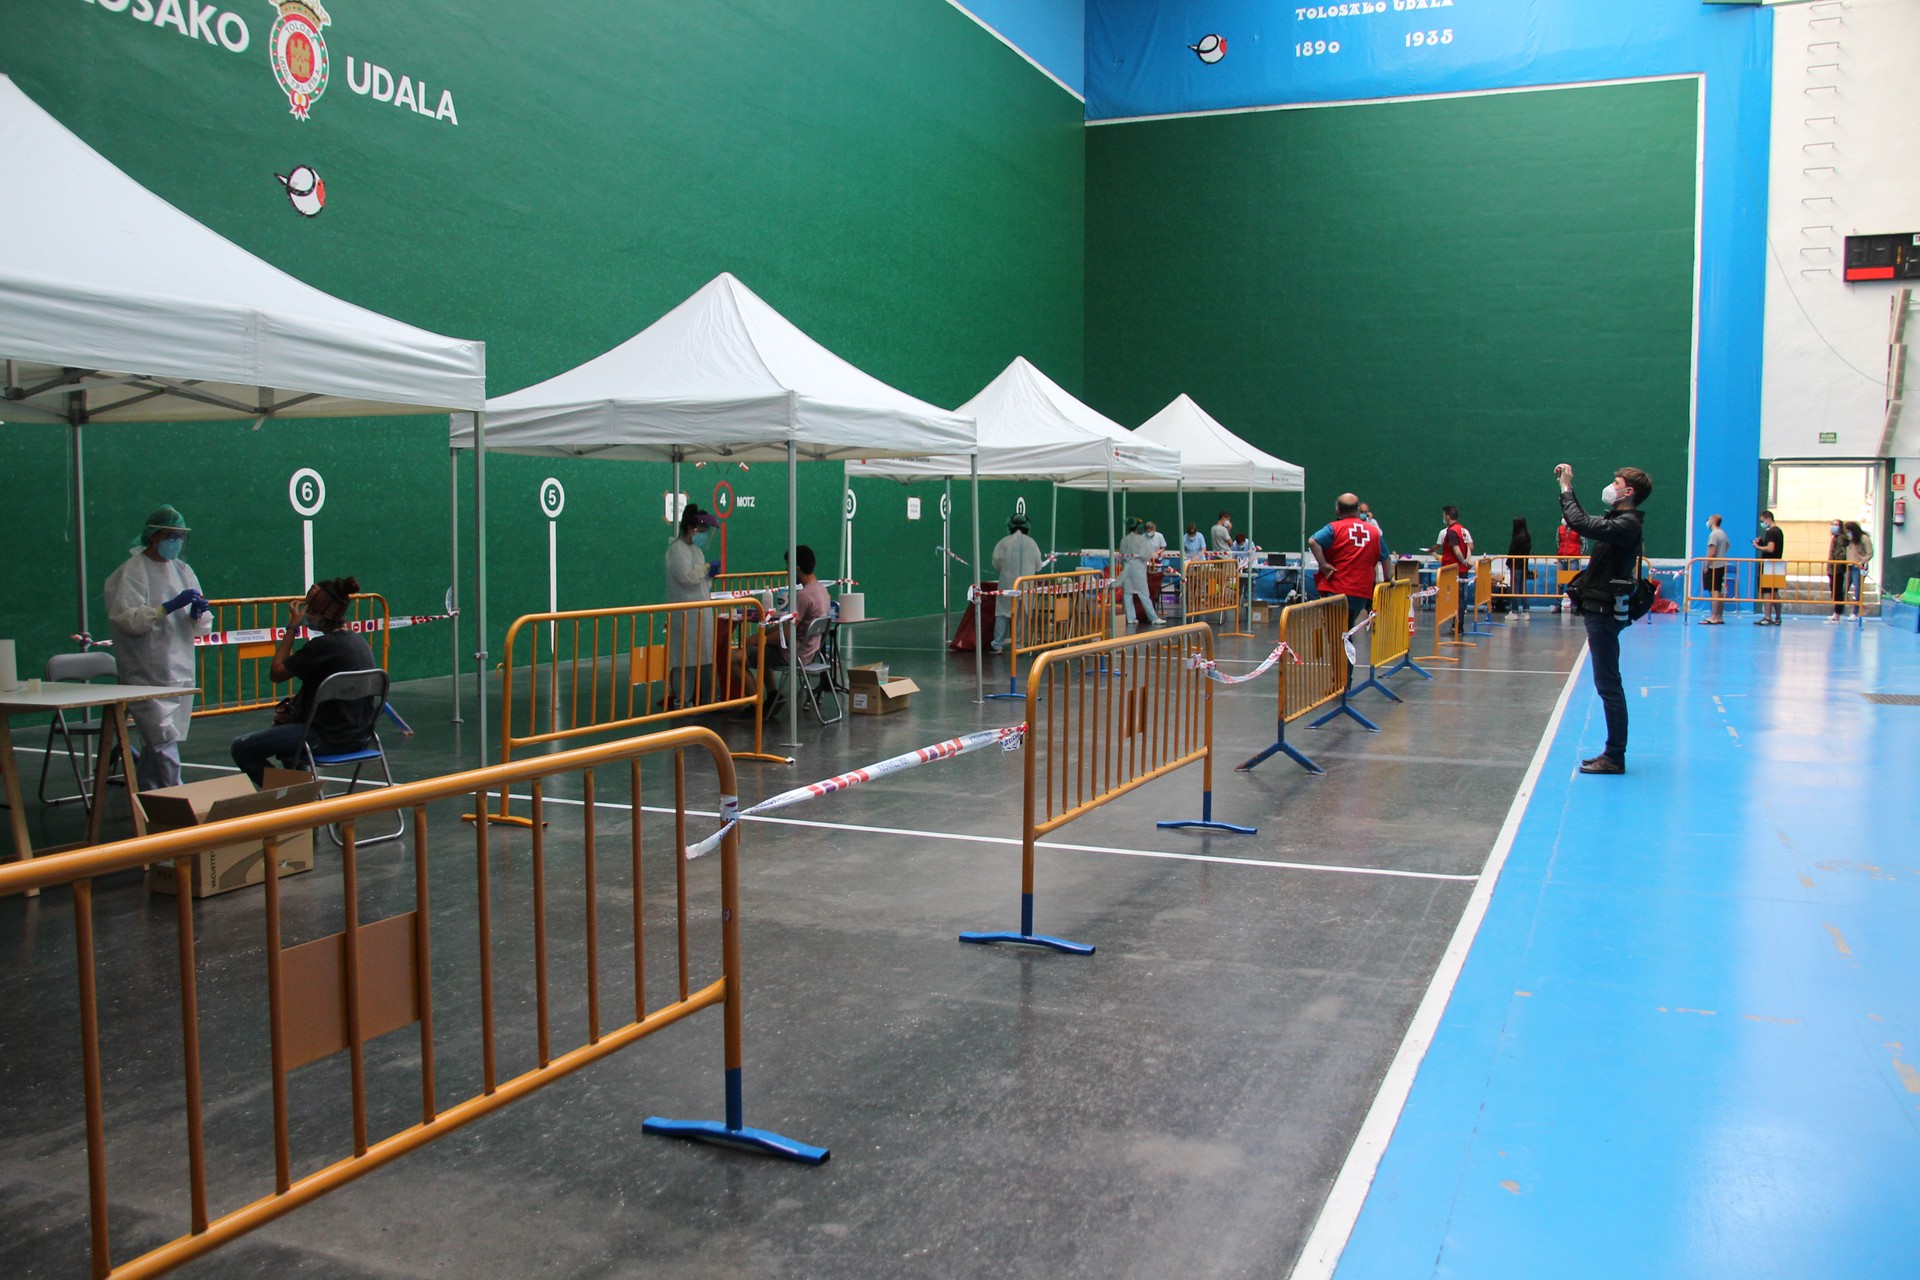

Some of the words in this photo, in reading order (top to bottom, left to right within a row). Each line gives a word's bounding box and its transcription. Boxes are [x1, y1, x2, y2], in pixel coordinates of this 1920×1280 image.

[1295, 40, 1341, 57] 1890
[1405, 28, 1454, 47] 1935
[346, 55, 459, 126] UDALA
[301, 481, 313, 501] 6
[548, 489, 557, 506] 5
[719, 492, 727, 507] 4
[736, 496, 756, 507] MOTZ
